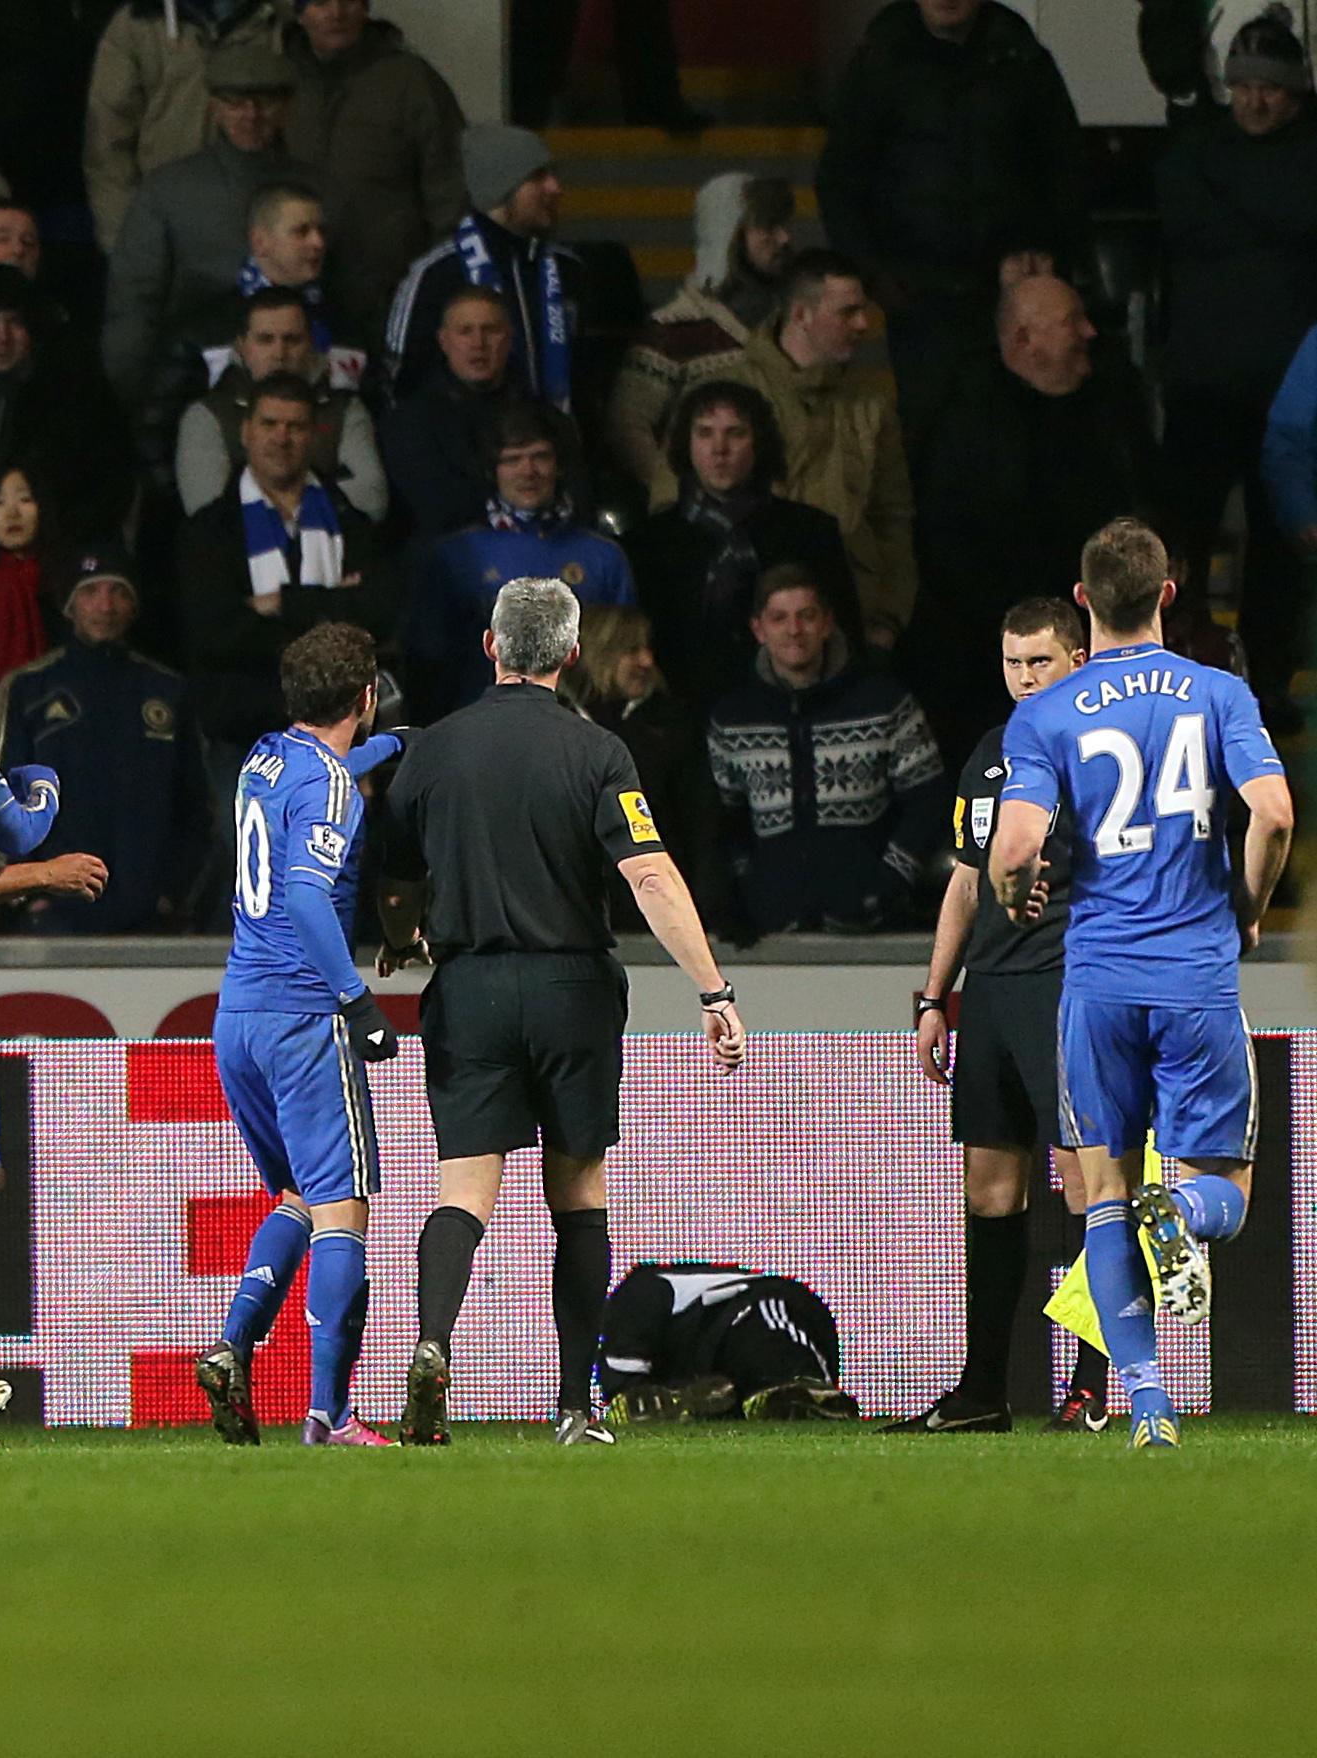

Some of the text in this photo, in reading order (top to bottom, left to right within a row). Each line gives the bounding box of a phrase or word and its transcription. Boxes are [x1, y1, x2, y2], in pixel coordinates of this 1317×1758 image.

[1074, 669, 1193, 715] CAHILL
[1078, 713, 1216, 858] 24
[632, 821, 654, 835] Exp
